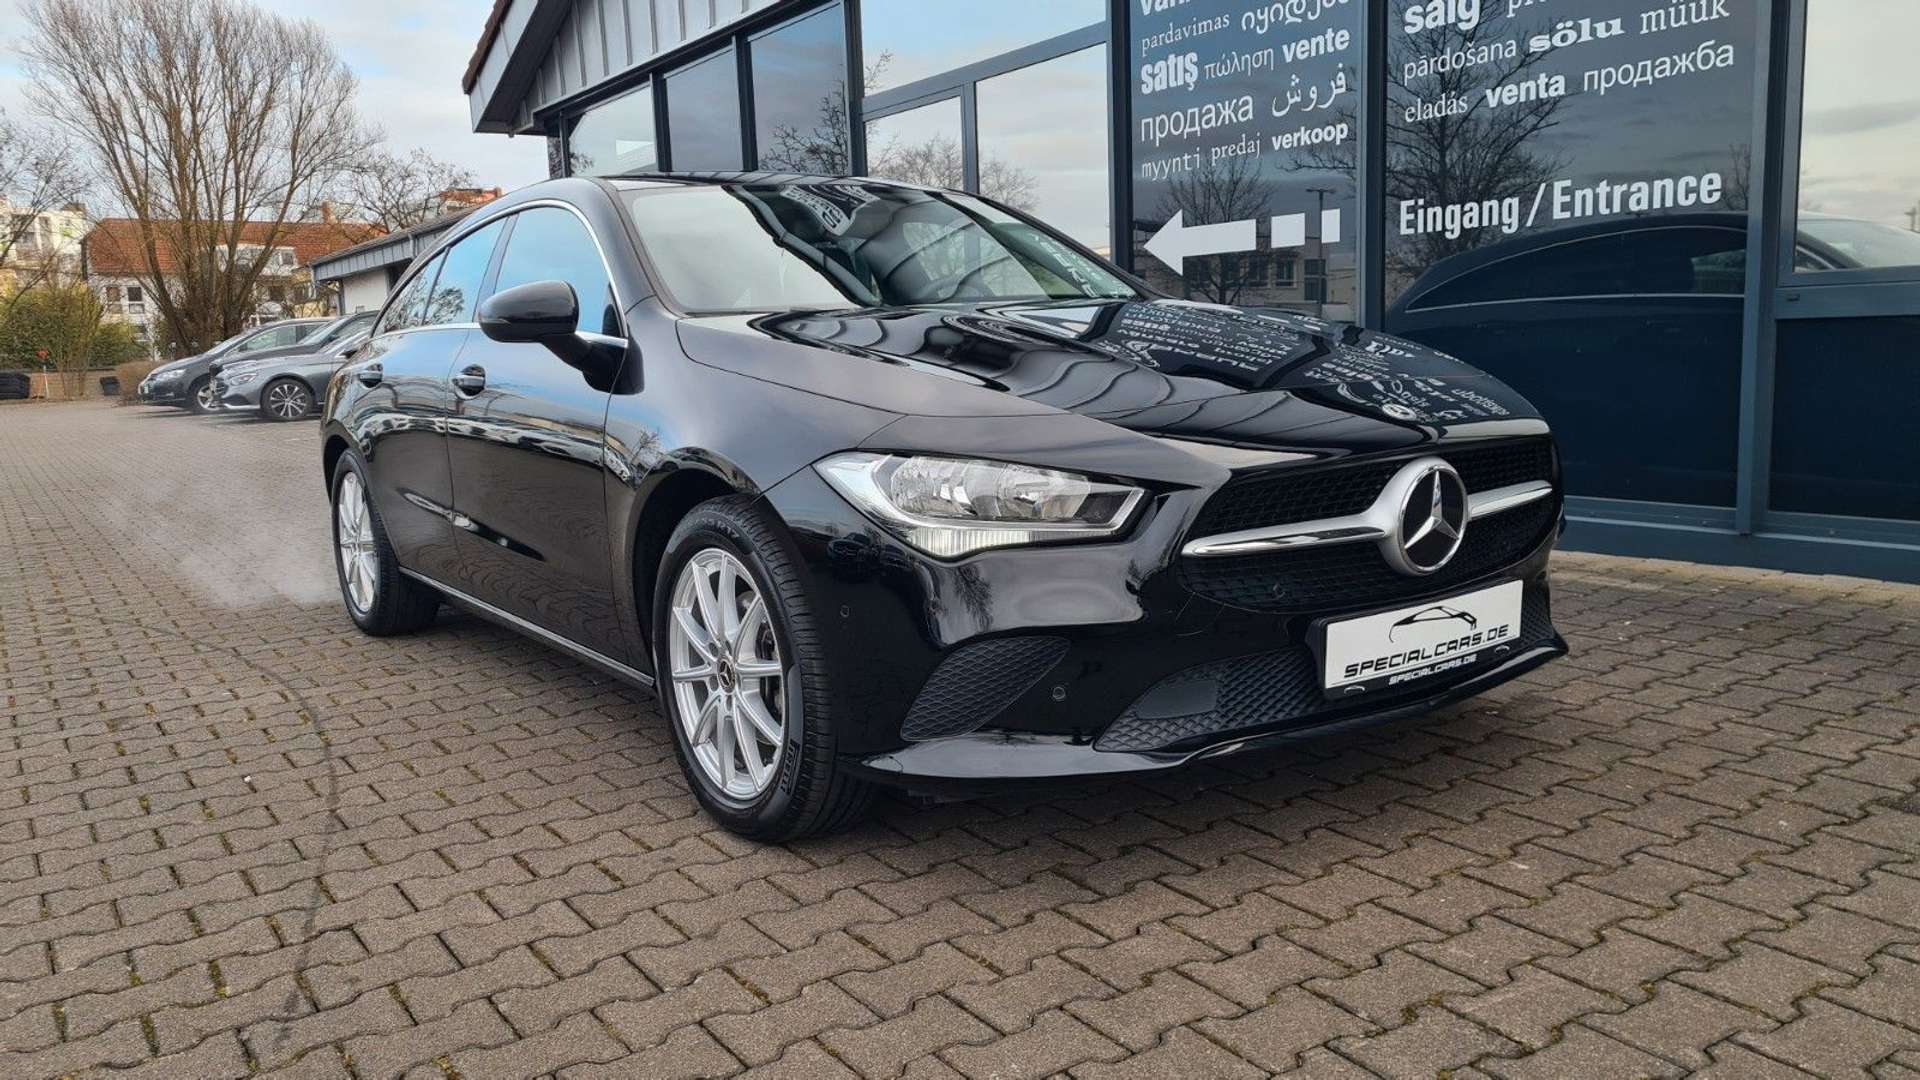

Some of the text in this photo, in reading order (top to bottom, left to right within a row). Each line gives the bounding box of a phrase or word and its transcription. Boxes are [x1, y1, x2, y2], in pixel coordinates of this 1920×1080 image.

[1141, 14, 1230, 57] pardavimas
[1282, 28, 1350, 63] vente
[1403, 40, 1517, 86] pārdošana
[1528, 16, 1626, 53] sölu
[1141, 52, 1199, 94] satış
[1204, 48, 1275, 79] πώληση
[1271, 62, 1347, 117] فروش
[1583, 40, 1735, 95] продажба
[1141, 95, 1254, 147] продажа
[1404, 73, 1566, 123] eladás venta
[1141, 122, 1349, 181] myynti predaj verkoop
[1399, 196, 1520, 240] Eingang
[1552, 171, 1722, 220] Entrance
[1344, 624, 1509, 679] SPECIALCARS.DE
